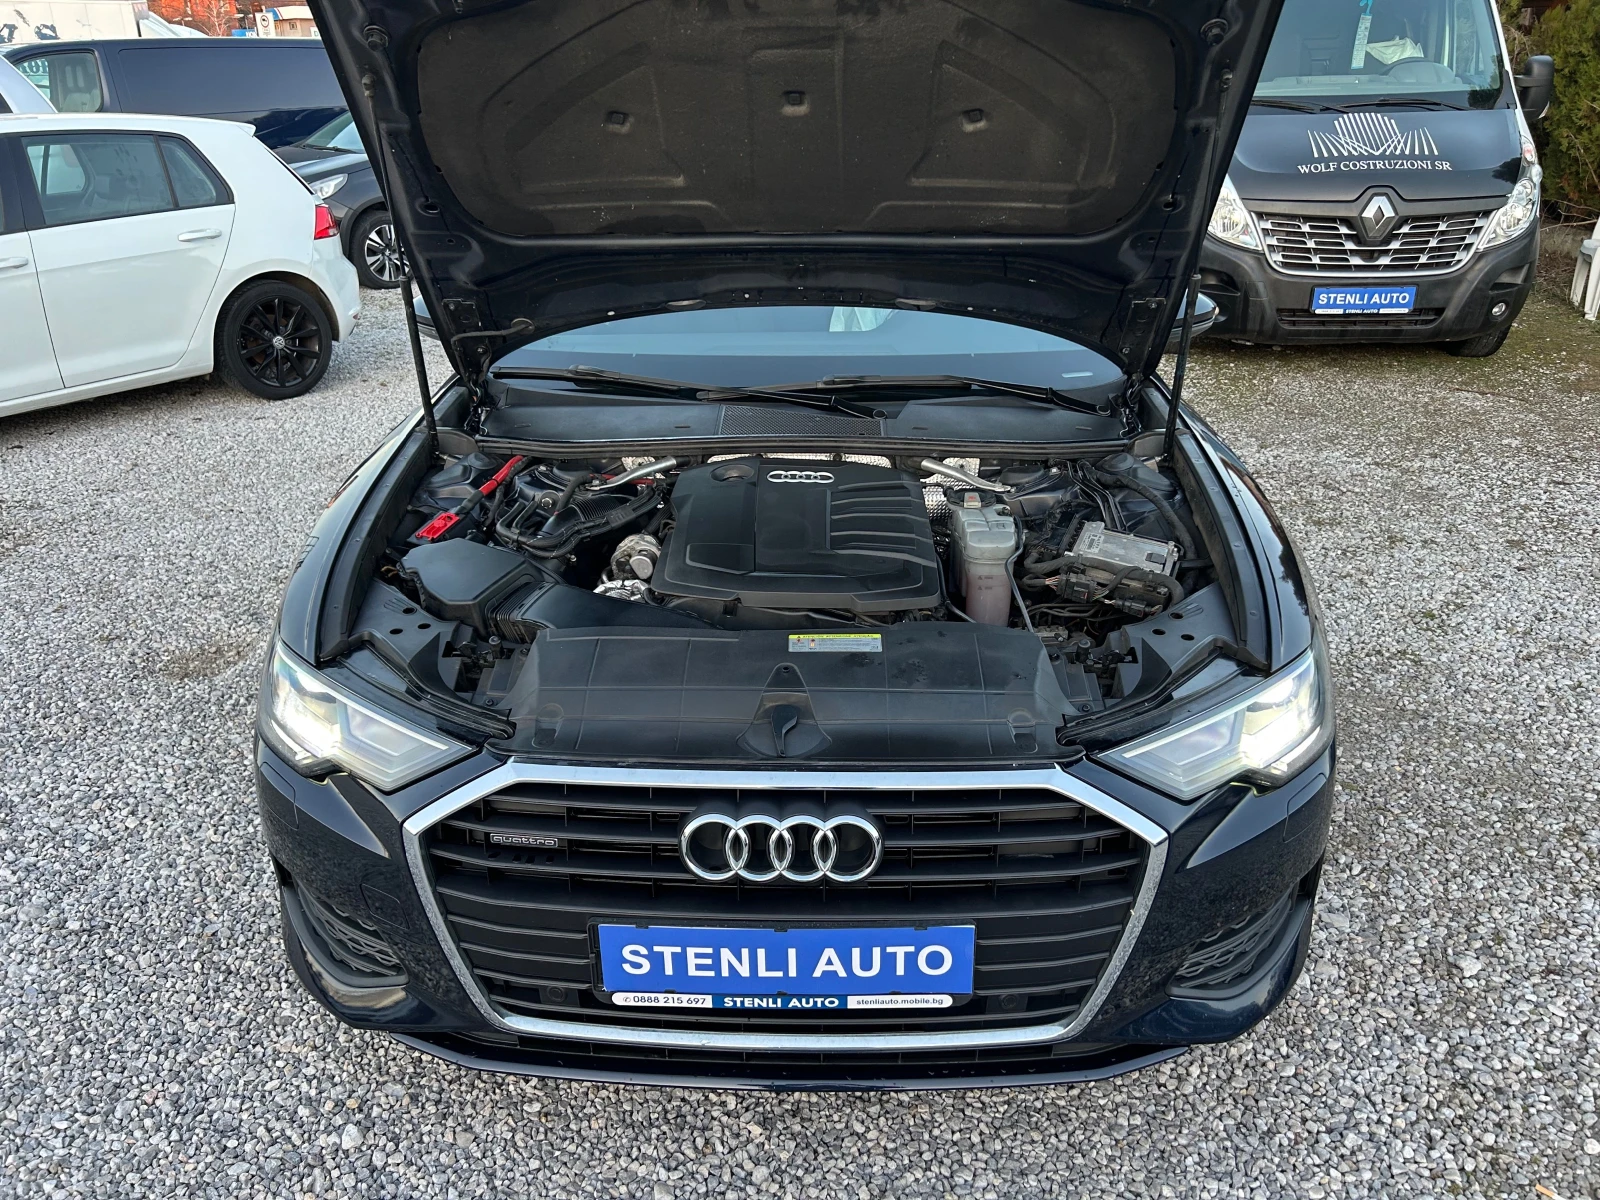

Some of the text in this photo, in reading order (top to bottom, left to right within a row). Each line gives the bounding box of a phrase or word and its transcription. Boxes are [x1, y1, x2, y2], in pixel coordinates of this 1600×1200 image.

[1297, 159, 1452, 174] WOLF COSTRUZIONI SR
[1318, 292, 1409, 305] STENLI AUTO
[493, 836, 554, 846] quattro
[621, 944, 953, 978] STENLI AUTO
[633, 995, 706, 1005] 0888 215 697
[723, 997, 840, 1008] STENLI AUTO
[856, 997, 944, 1006] stenliauto.mobile.bg
